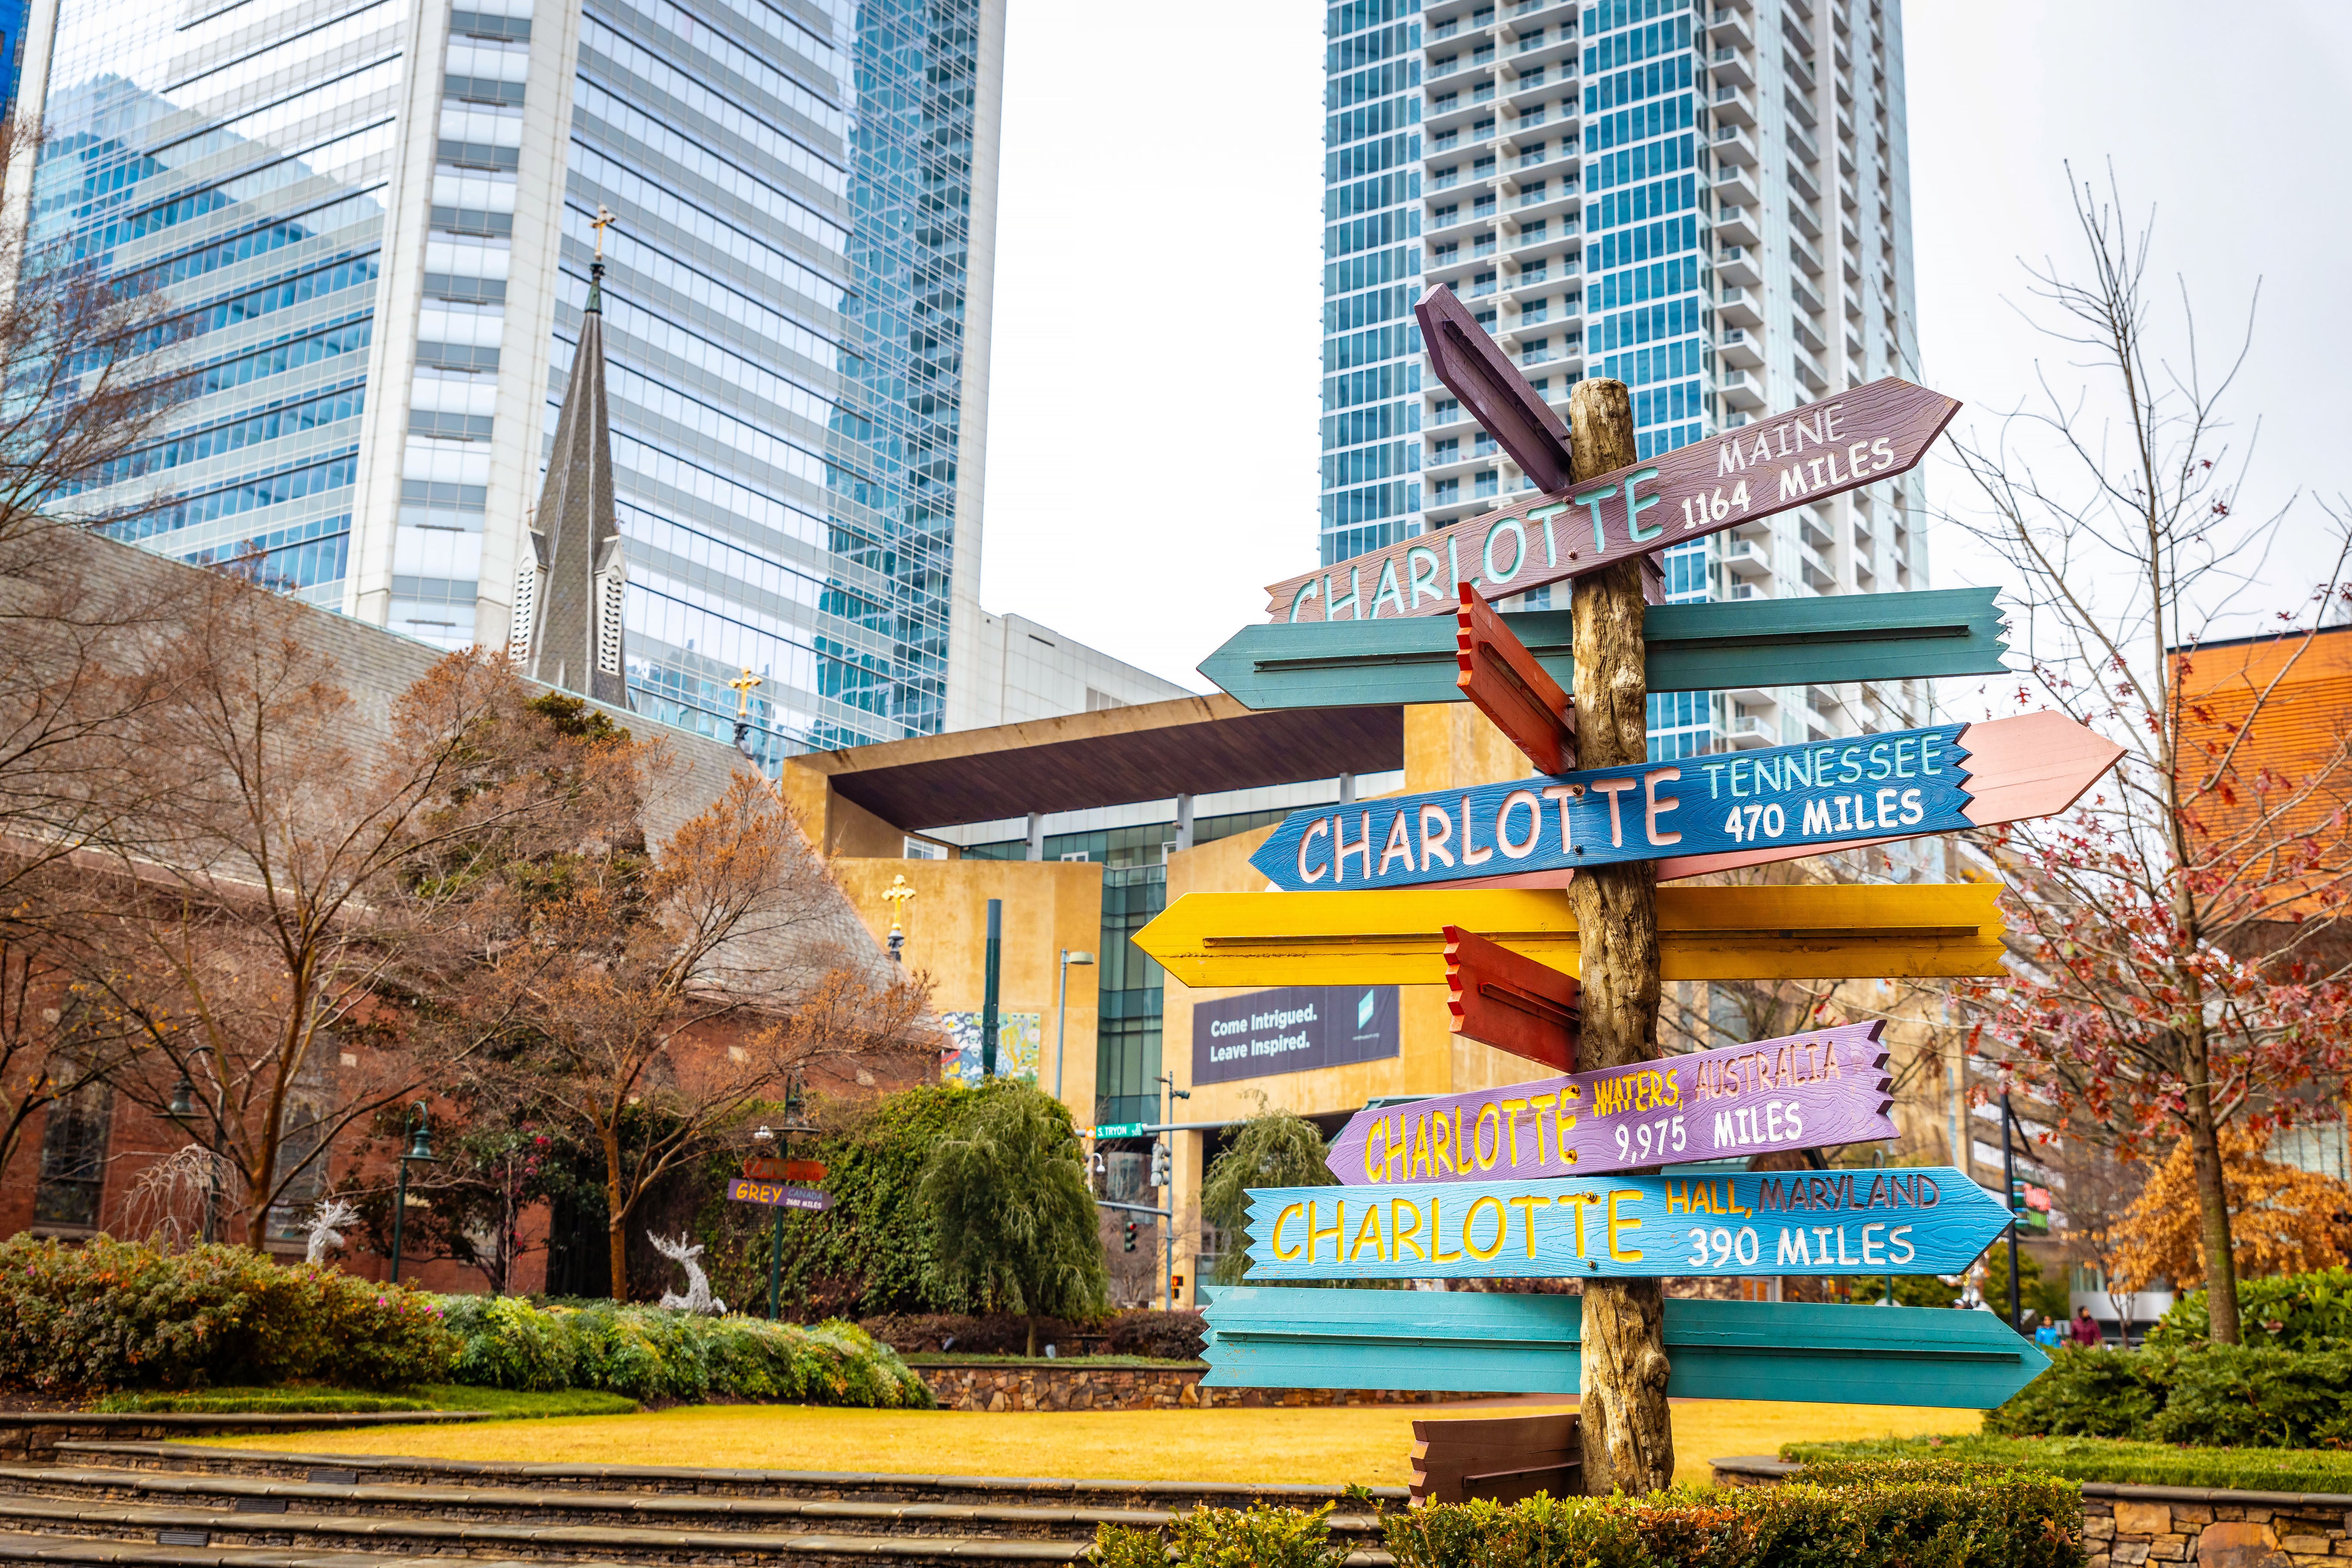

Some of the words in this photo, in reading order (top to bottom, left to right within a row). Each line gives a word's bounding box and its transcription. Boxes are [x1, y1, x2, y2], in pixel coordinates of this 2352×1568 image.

[1718, 402, 1846, 477] MAINE
[1682, 480, 1751, 530] 1164
[1779, 437, 1894, 502] MILES
[1289, 467, 1663, 622] CHARLOTTE
[1701, 732, 1943, 799] TENNESSEE
[1298, 767, 1682, 883] CHARLOTTE
[1725, 803, 1785, 842] 470
[1802, 788, 1924, 836] MILES
[1210, 1018, 1248, 1037] Come
[1251, 1003, 1318, 1030] Intrigued.
[1210, 1045, 1248, 1062] Leave
[1251, 1031, 1310, 1057] Inspired.
[1593, 1068, 1683, 1117] WATERS,
[1695, 1041, 1841, 1102] AUSTRALIA
[1105, 1126, 1127, 1135] TRYON
[1365, 1085, 1581, 1183] CHARLOTTE
[1615, 1115, 1687, 1164] 9,975
[1714, 1101, 1802, 1148] MILES
[736, 1183, 783, 1202] GREY
[788, 1189, 823, 1200] CANADA
[749, 1159, 787, 1178] ZANE
[1666, 1179, 1752, 1218] HALL,
[1759, 1173, 1940, 1212] MARYLAND
[801, 1200, 822, 1209] MILES
[1273, 1189, 1643, 1264] CHARLOTTE
[1688, 1226, 1759, 1267] 390
[1777, 1223, 1915, 1265] MILES
